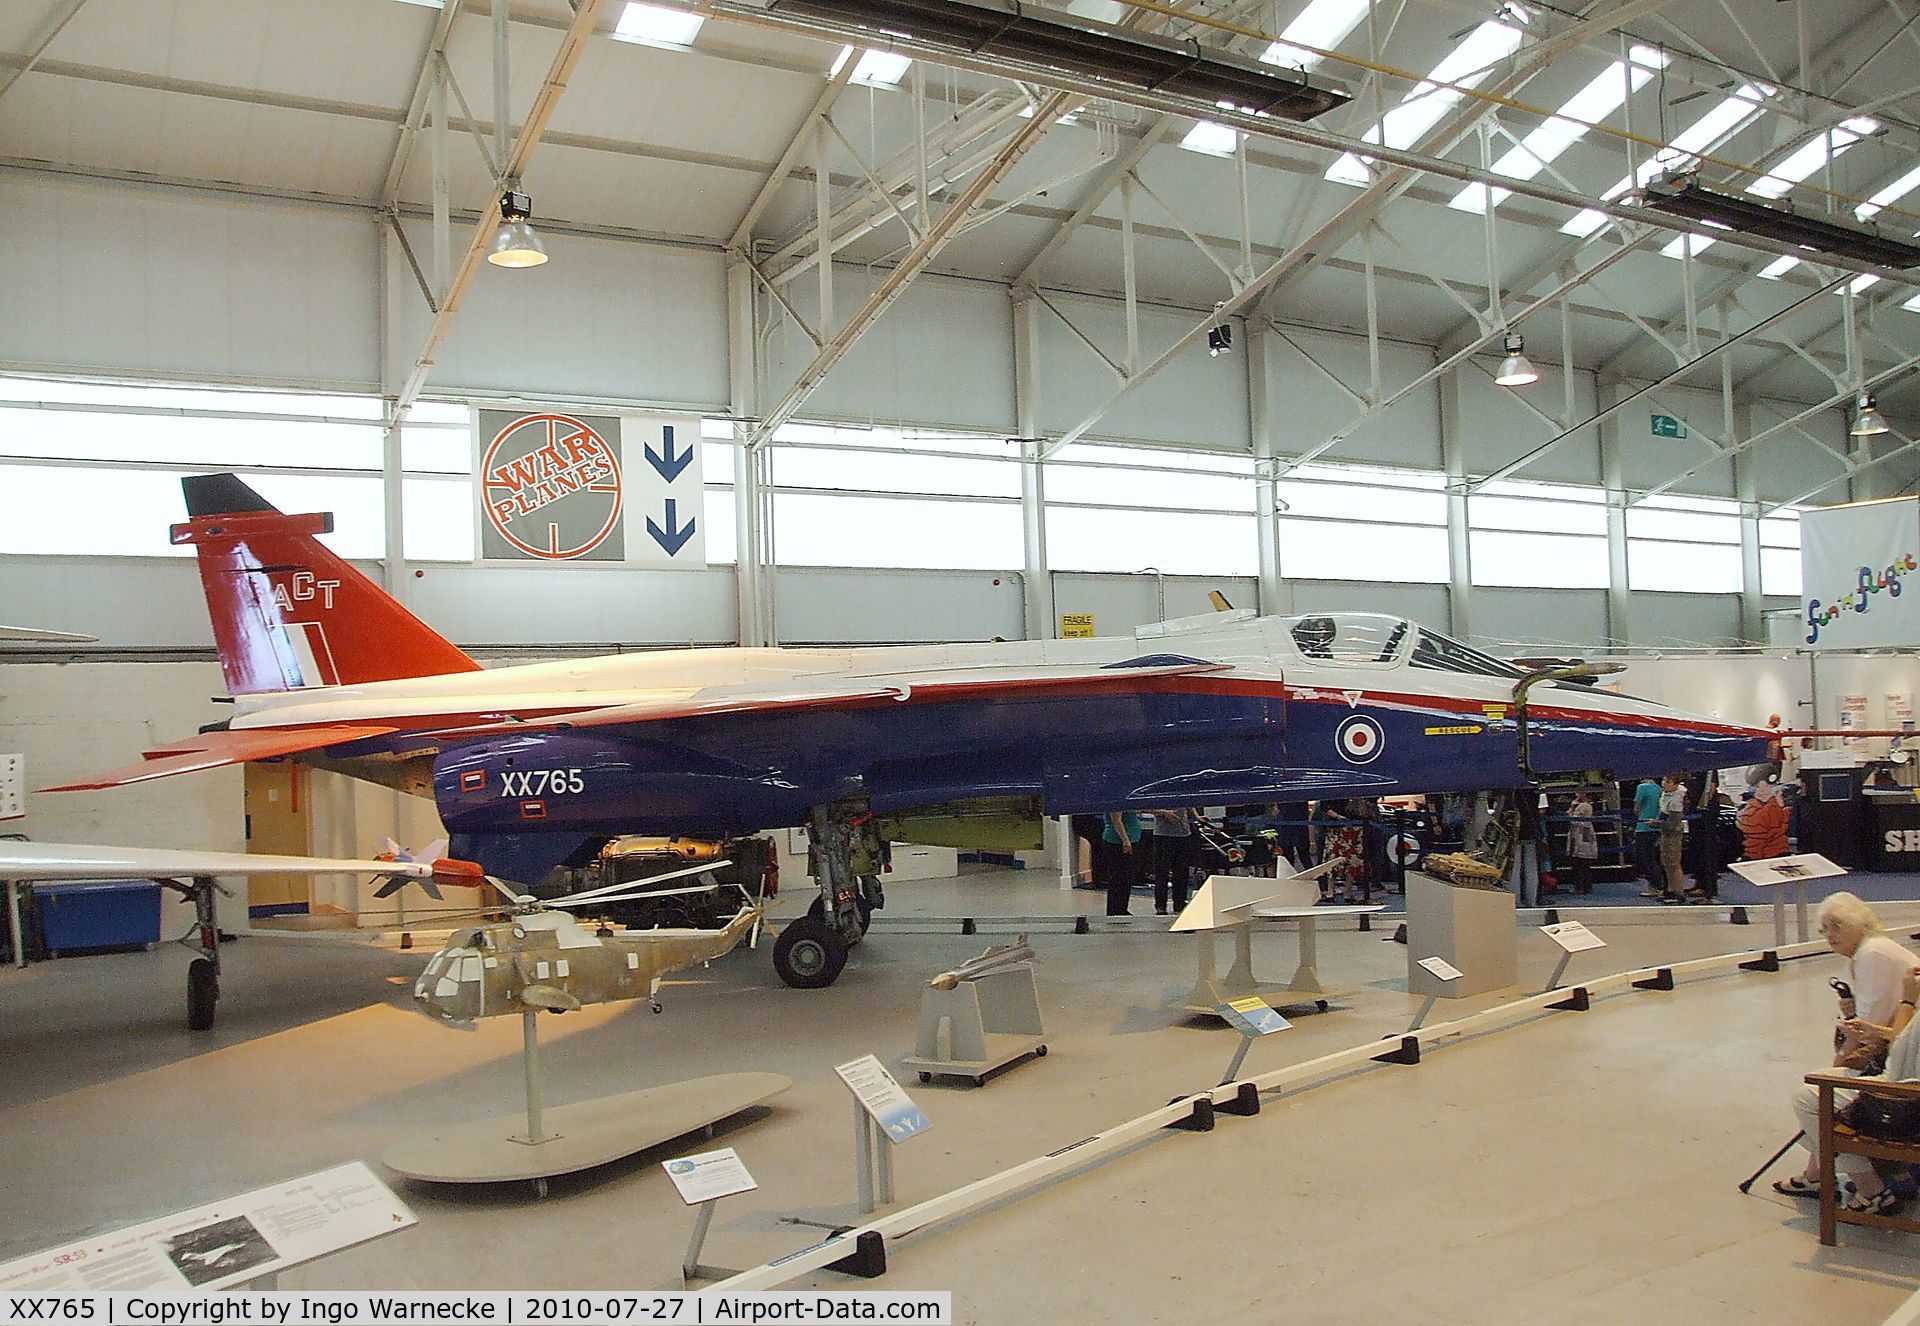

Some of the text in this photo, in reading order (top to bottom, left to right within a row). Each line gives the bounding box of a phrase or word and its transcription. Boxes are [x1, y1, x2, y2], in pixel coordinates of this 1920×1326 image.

[493, 431, 600, 493] WAR
[493, 455, 613, 524] PLANES
[271, 571, 341, 612] ACT
[1063, 615, 1092, 624] FRAGILE
[1438, 726, 1473, 734] RESCUE
[500, 768, 585, 797] XX765
